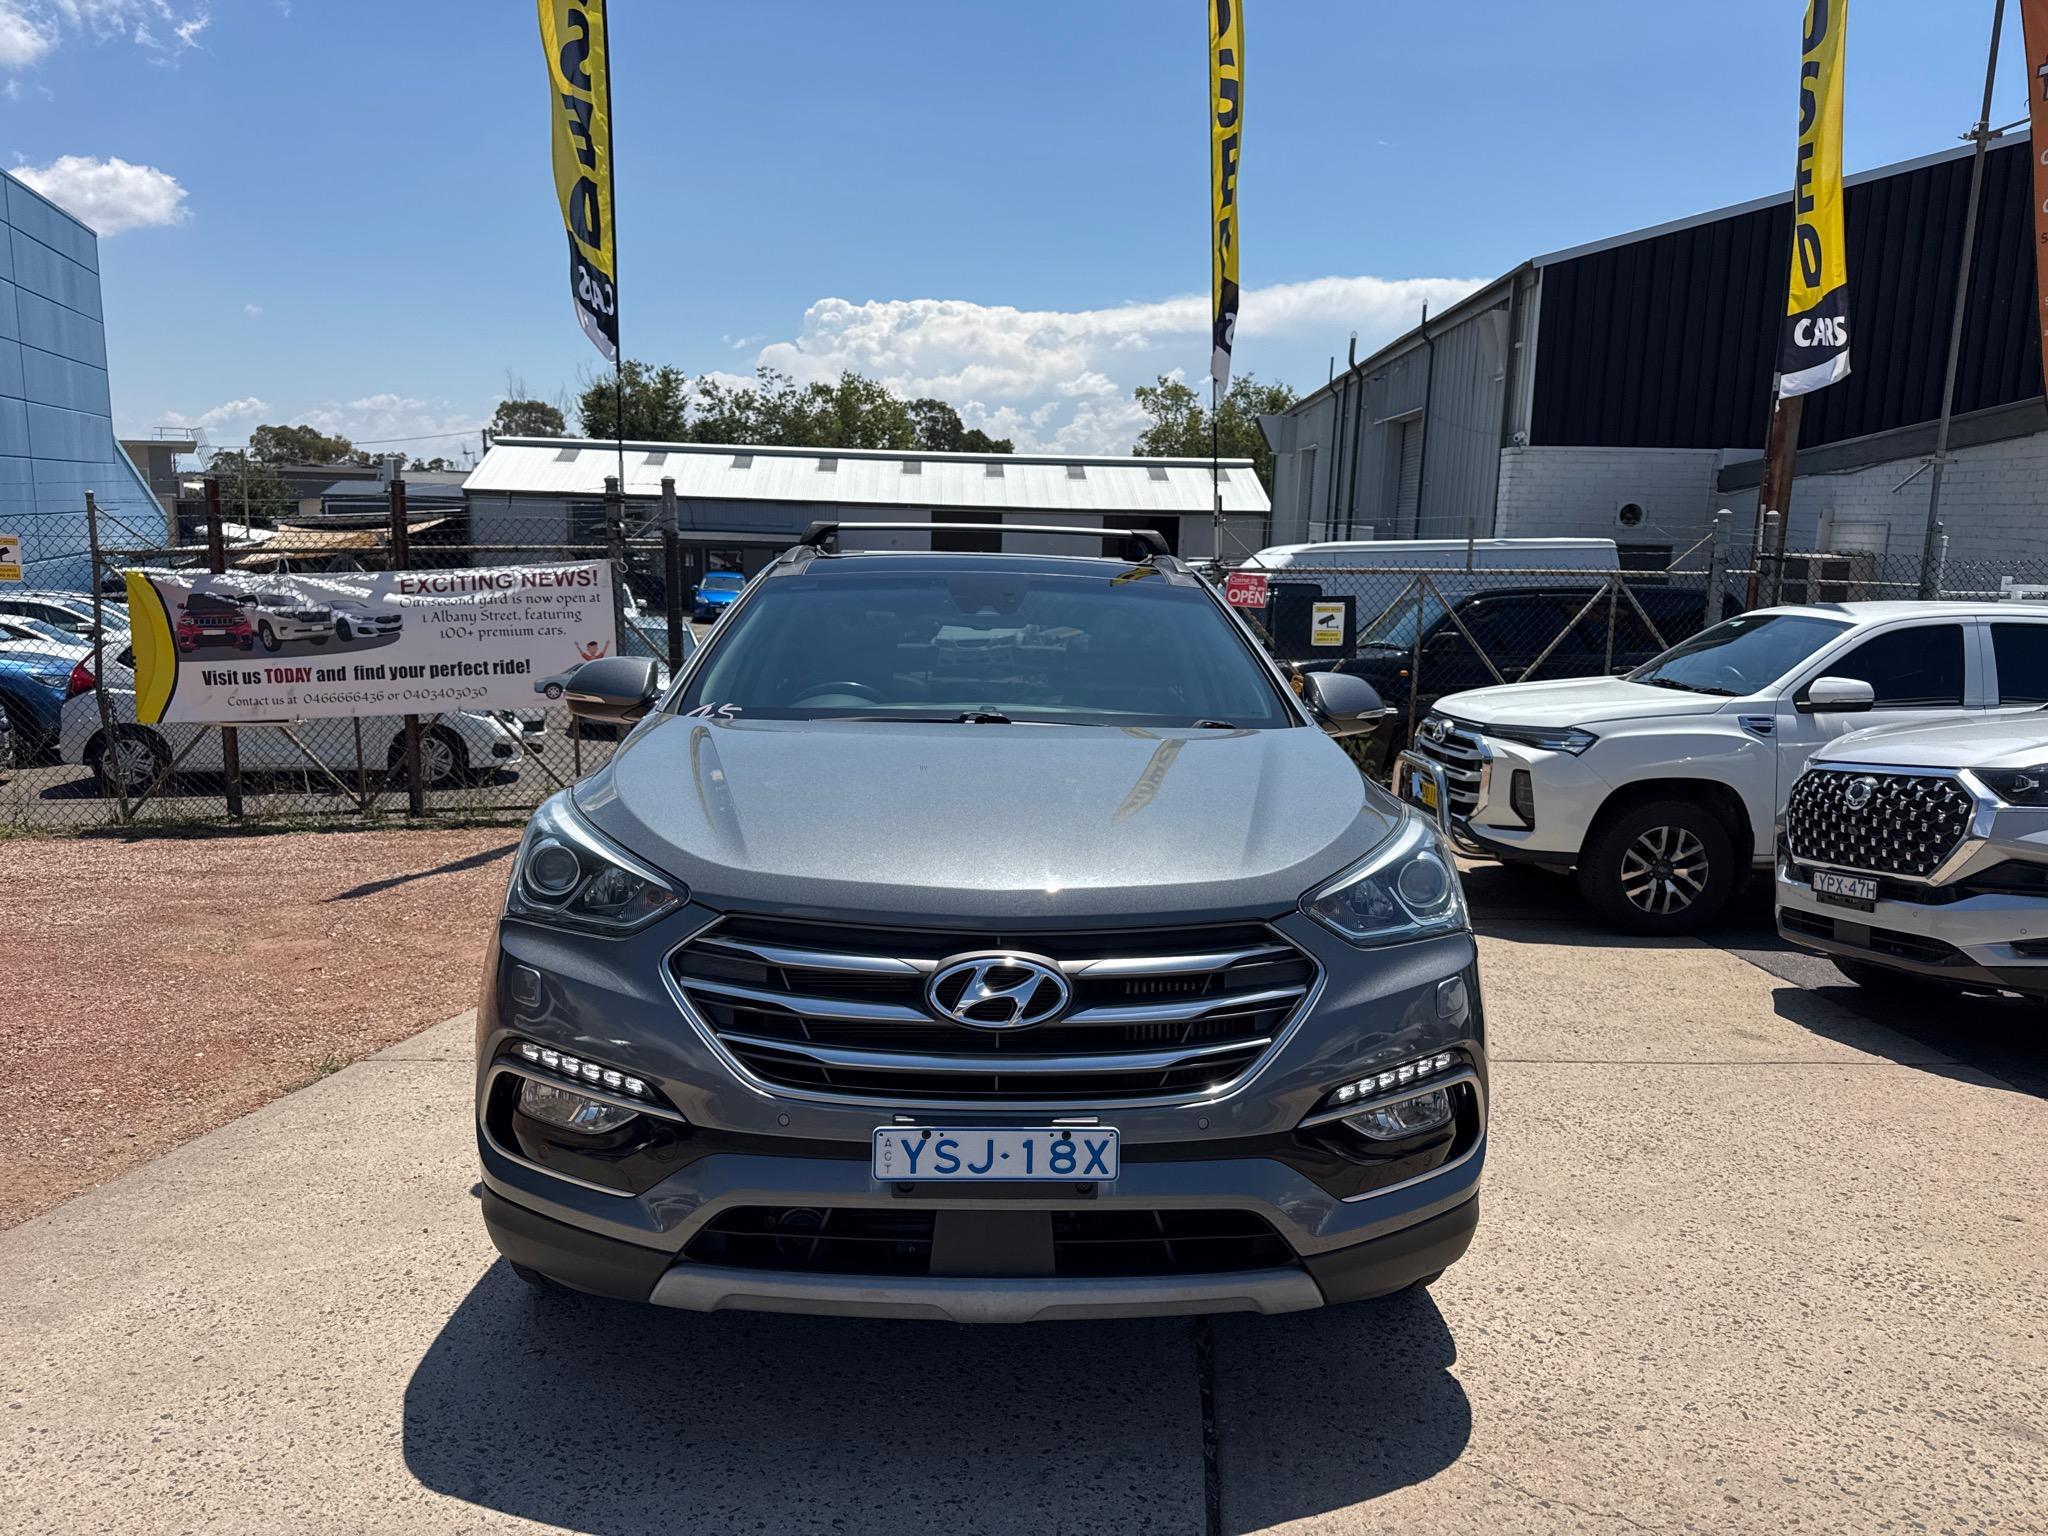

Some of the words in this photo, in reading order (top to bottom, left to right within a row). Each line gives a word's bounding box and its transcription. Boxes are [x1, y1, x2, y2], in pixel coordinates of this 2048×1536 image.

[1794, 315, 1847, 347] CARS
[400, 574, 512, 595] EXCITING
[521, 569, 599, 588] NEWS!
[400, 597, 427, 609] Our
[431, 593, 475, 607] second
[479, 592, 508, 609] yard
[512, 594, 522, 605] is
[526, 594, 553, 605] now
[556, 593, 584, 607] open
[588, 592, 601, 604] at
[1228, 588, 1265, 604] OPEN
[431, 609, 477, 625] Albany
[480, 609, 521, 623] Street,
[525, 607, 583, 623] featuring
[440, 626, 474, 640] 100+
[478, 624, 534, 642] premium
[537, 626, 567, 637] cars.
[202, 669, 239, 686] Visit
[242, 671, 262, 685] us
[264, 667, 312, 684] TODAY
[316, 666, 346, 682] and
[354, 664, 386, 681] find
[388, 665, 426, 681] your
[429, 660, 490, 679] perfect
[493, 658, 531, 675] ride!
[227, 695, 269, 707] Contact
[272, 697, 285, 705] us
[287, 695, 298, 705] at
[387, 691, 401, 701] or
[402, 686, 488, 701] 0403403030
